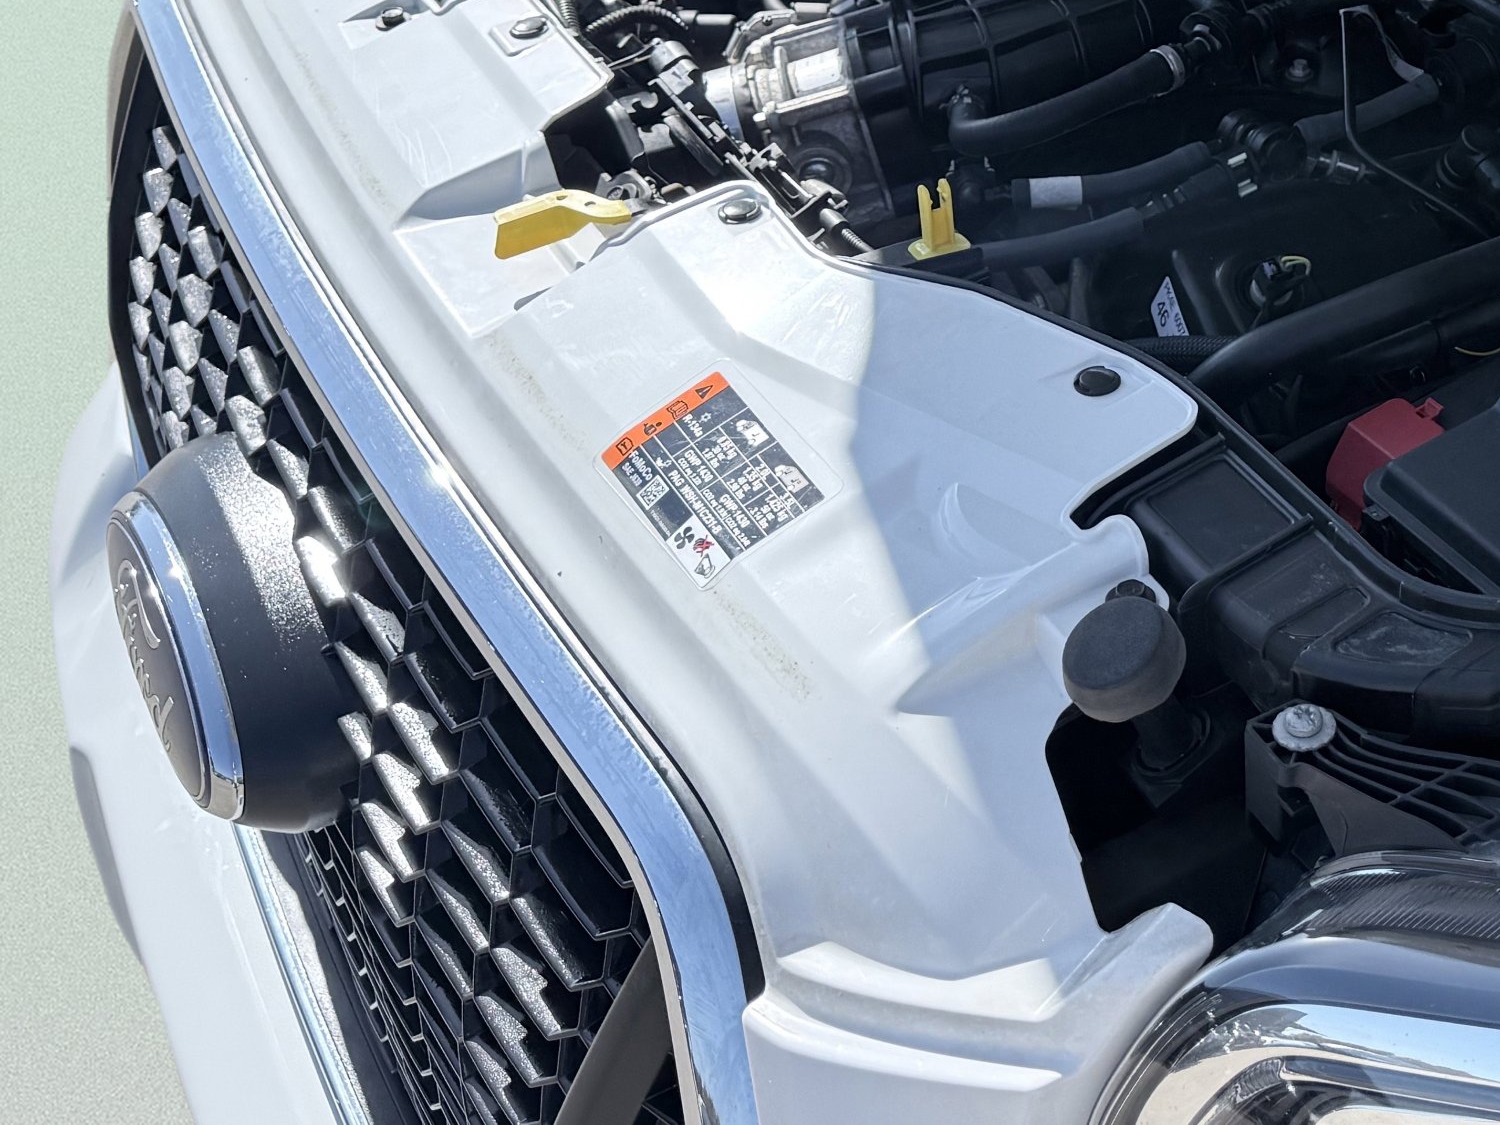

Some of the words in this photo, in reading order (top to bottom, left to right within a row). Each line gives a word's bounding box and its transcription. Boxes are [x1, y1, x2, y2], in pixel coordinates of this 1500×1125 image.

[681, 412, 706, 437] R-134a
[715, 451, 726, 461] oz
[723, 446, 739, 461] kg
[620, 461, 635, 476] SAE
[626, 450, 656, 482] FoMoCo
[682, 448, 702, 468] GWP
[695, 463, 714, 483] 1430
[708, 456, 722, 469] lbs
[667, 468, 686, 487] PAG
[741, 465, 759, 483] 1.35
[754, 462, 772, 480] 2.0L
[740, 482, 751, 492] oz
[748, 477, 765, 492] kg
[733, 487, 747, 500] lbs
[757, 516, 771, 529] lbs
[764, 511, 775, 521] oz
[773, 507, 790, 523] kg
[114, 559, 175, 752] Ford
